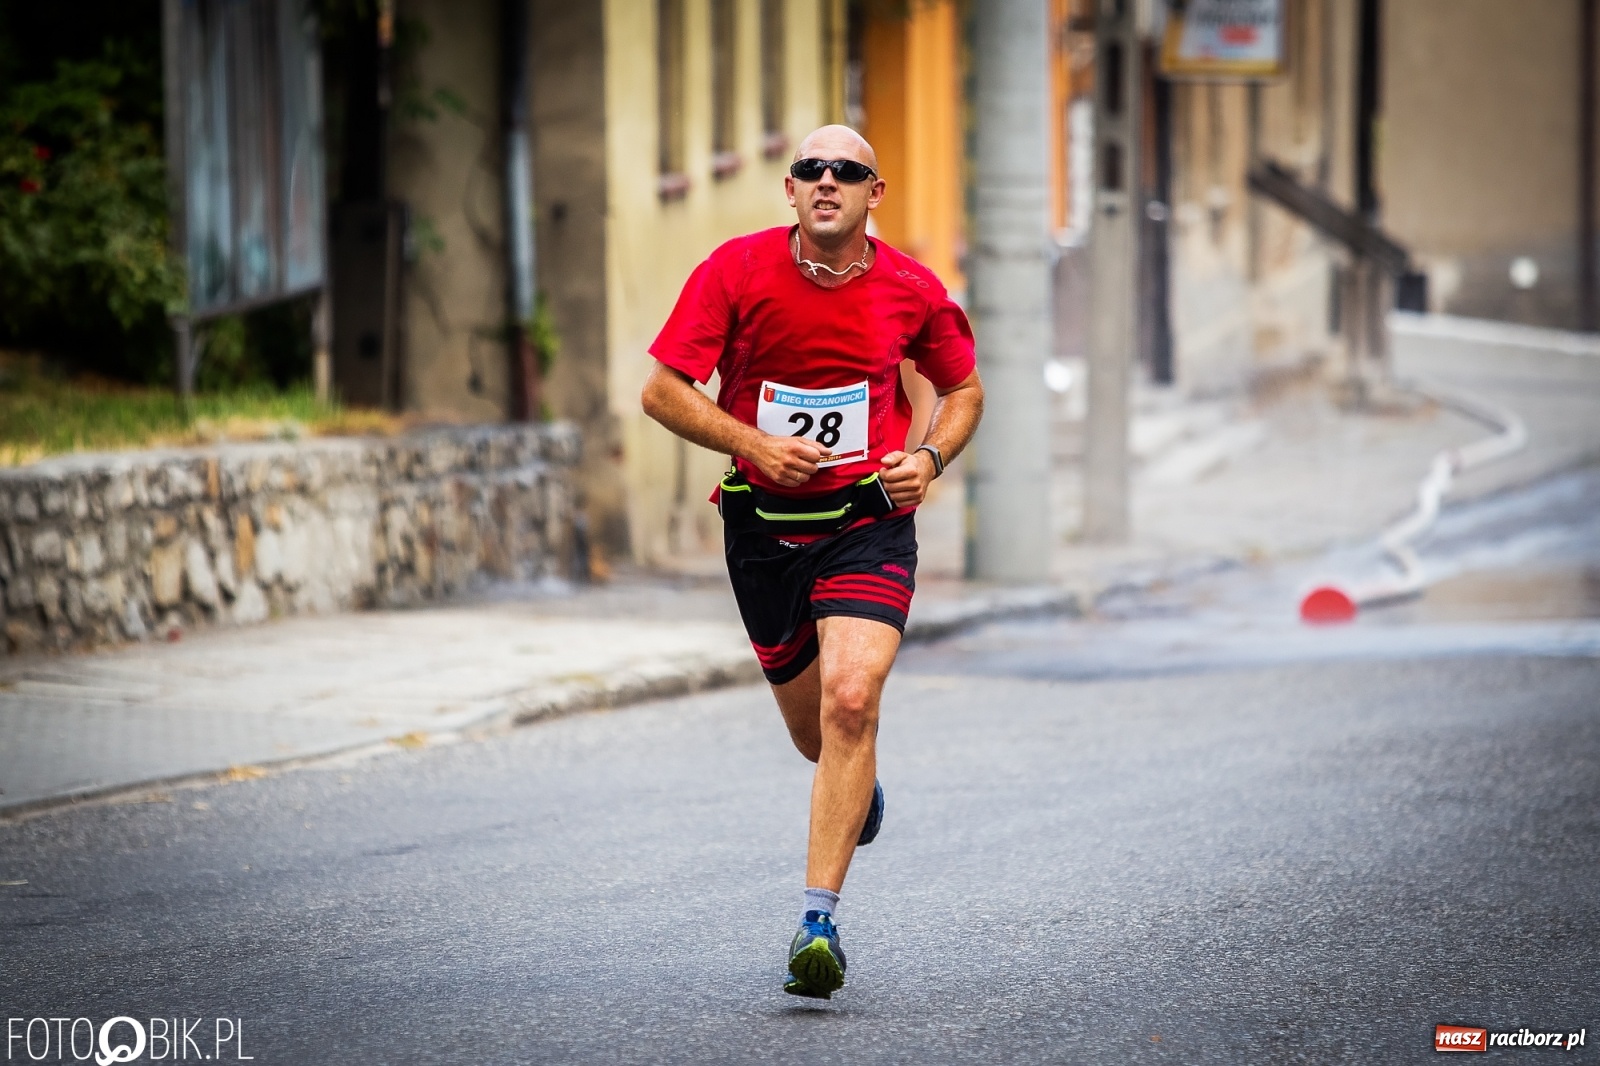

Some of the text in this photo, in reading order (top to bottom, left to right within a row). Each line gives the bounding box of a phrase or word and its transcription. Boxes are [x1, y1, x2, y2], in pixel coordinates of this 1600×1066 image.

[775, 391, 864, 406] I BIEG KRZANOWICKI
[787, 411, 843, 449] 28
